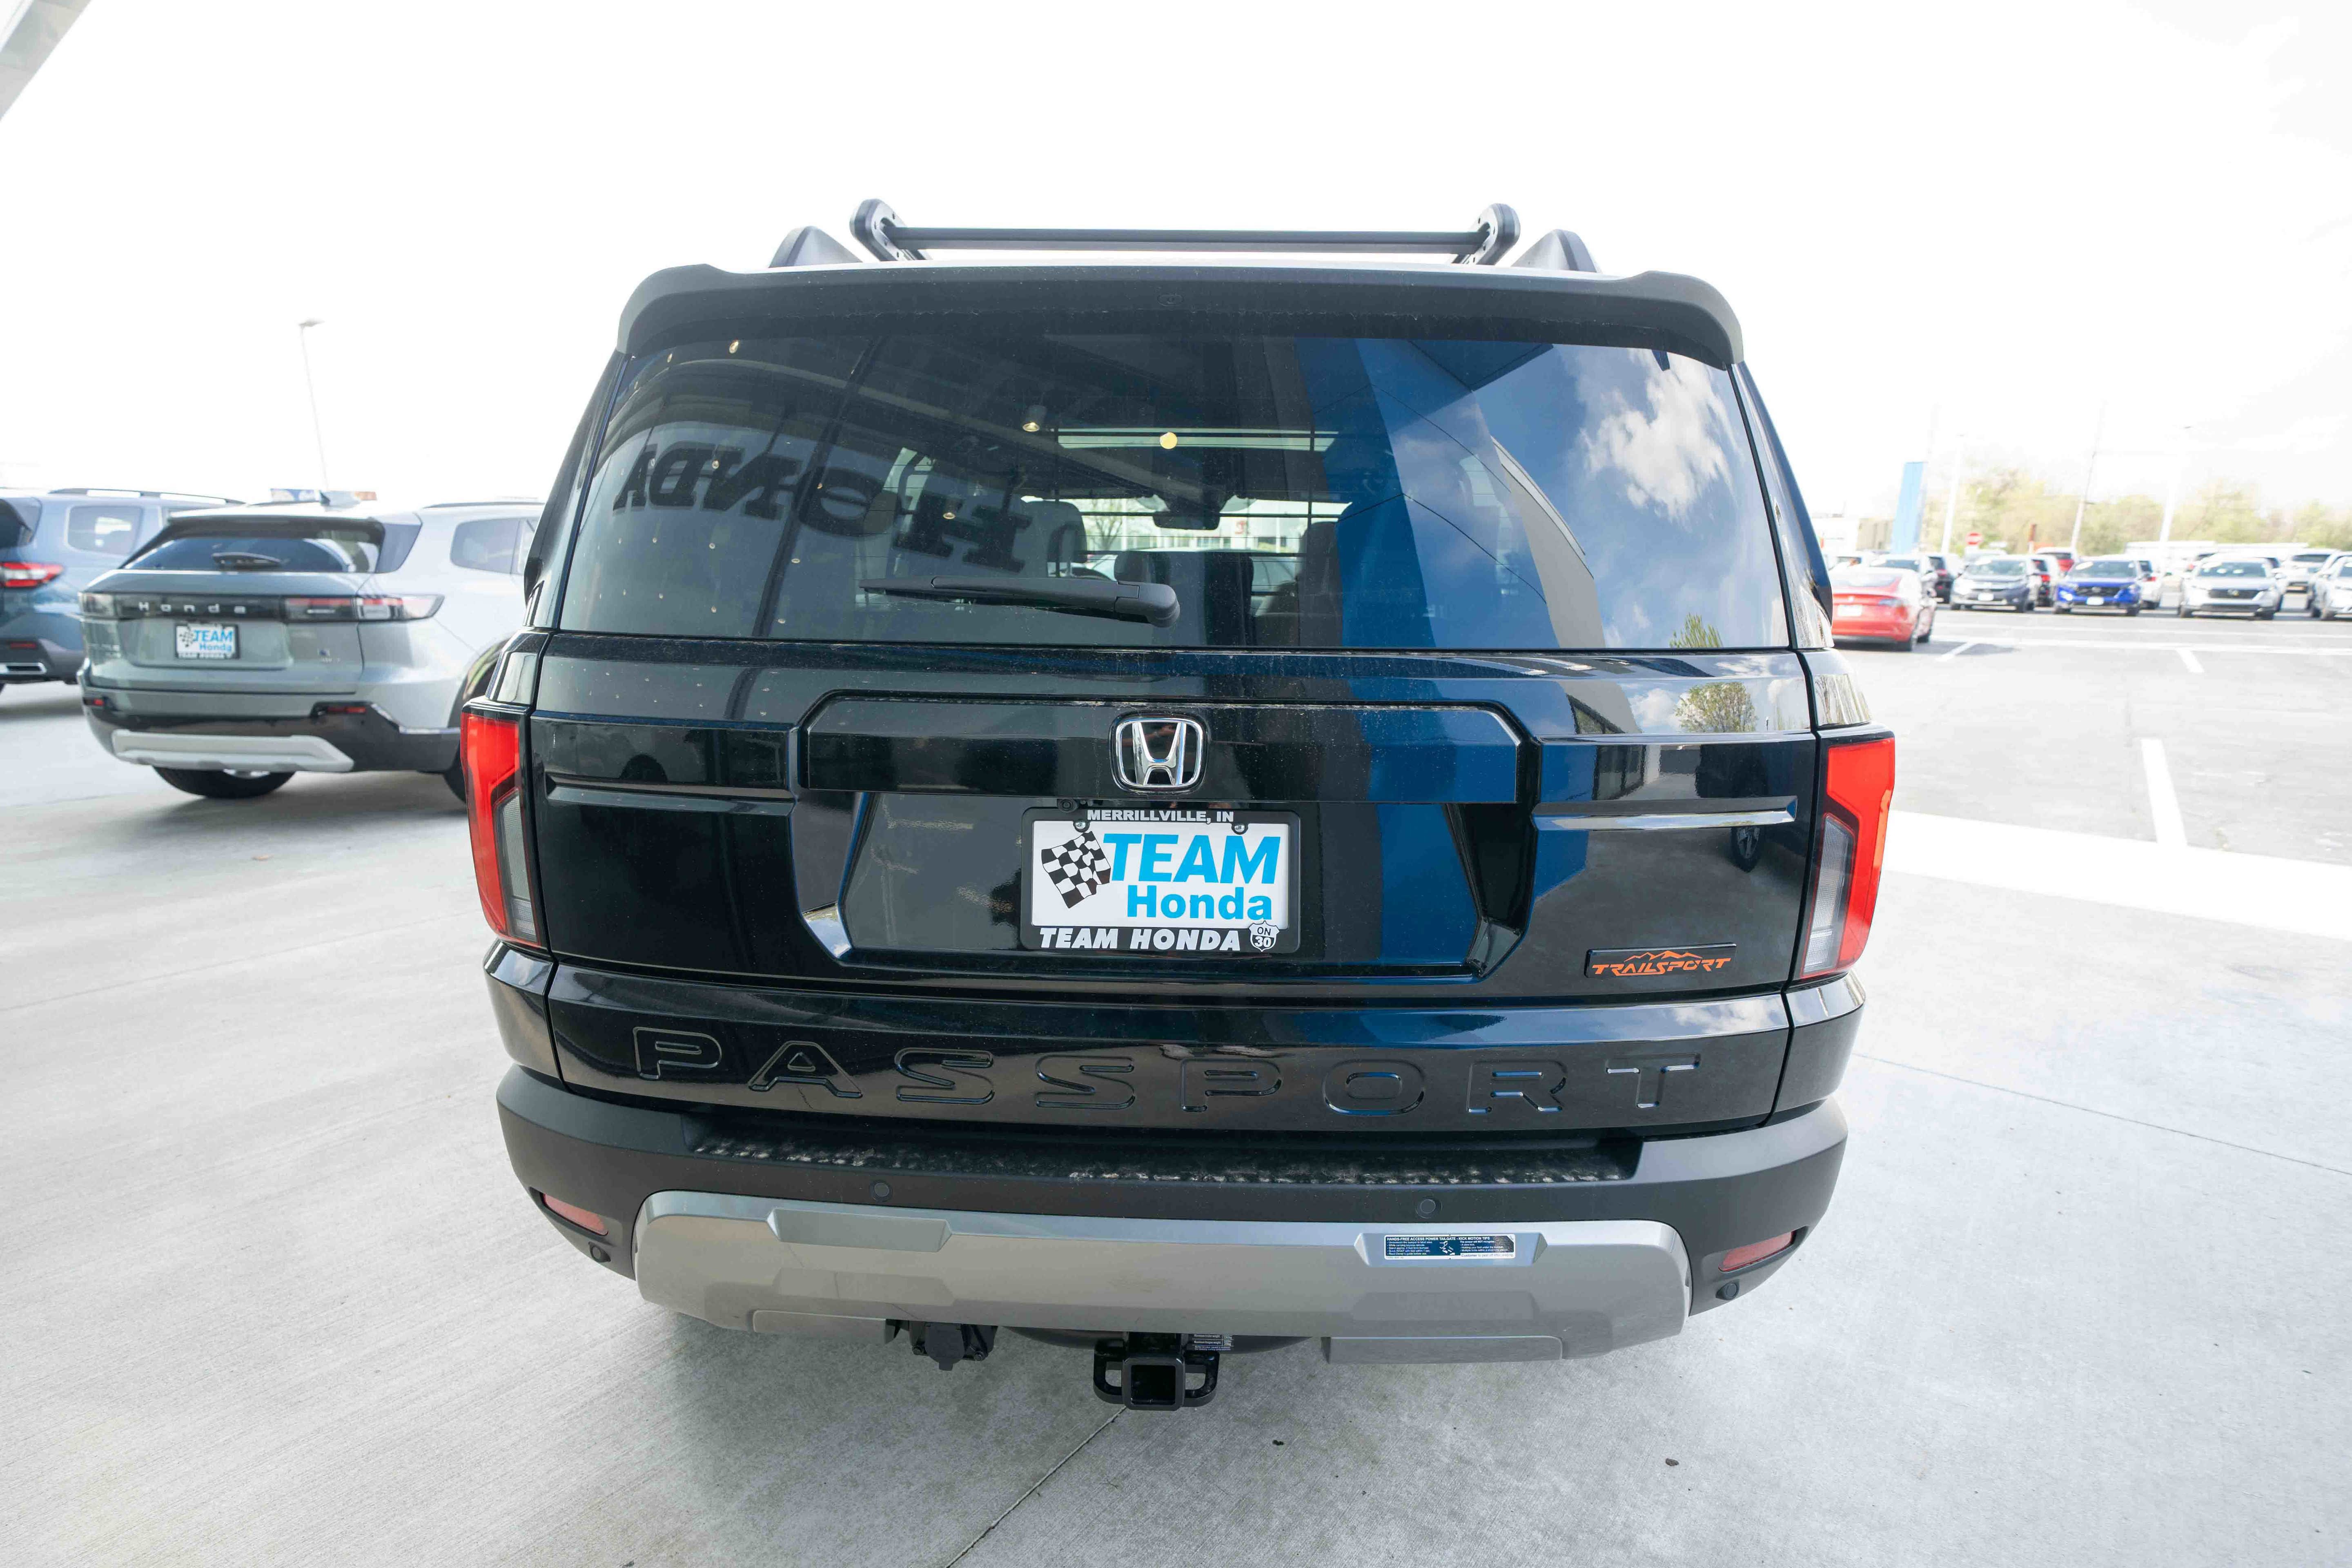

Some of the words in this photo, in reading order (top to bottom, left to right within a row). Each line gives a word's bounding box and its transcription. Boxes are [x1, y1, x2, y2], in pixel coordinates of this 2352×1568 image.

[193, 630, 234, 641] TEAM
[199, 643, 232, 652] Honda
[1087, 809, 1212, 824] MERRILLVILLE,
[1216, 811, 1234, 822] IN
[1103, 833, 1281, 884] TEAM
[1127, 884, 1272, 920] Honda
[1257, 926, 1271, 935] ON
[1040, 927, 1118, 949] TEAM
[1130, 929, 1241, 951] HONDA
[1255, 936, 1271, 947] 30
[1592, 958, 1731, 976] TRAILSPORT
[632, 1026, 1700, 1116] PASSPORT
